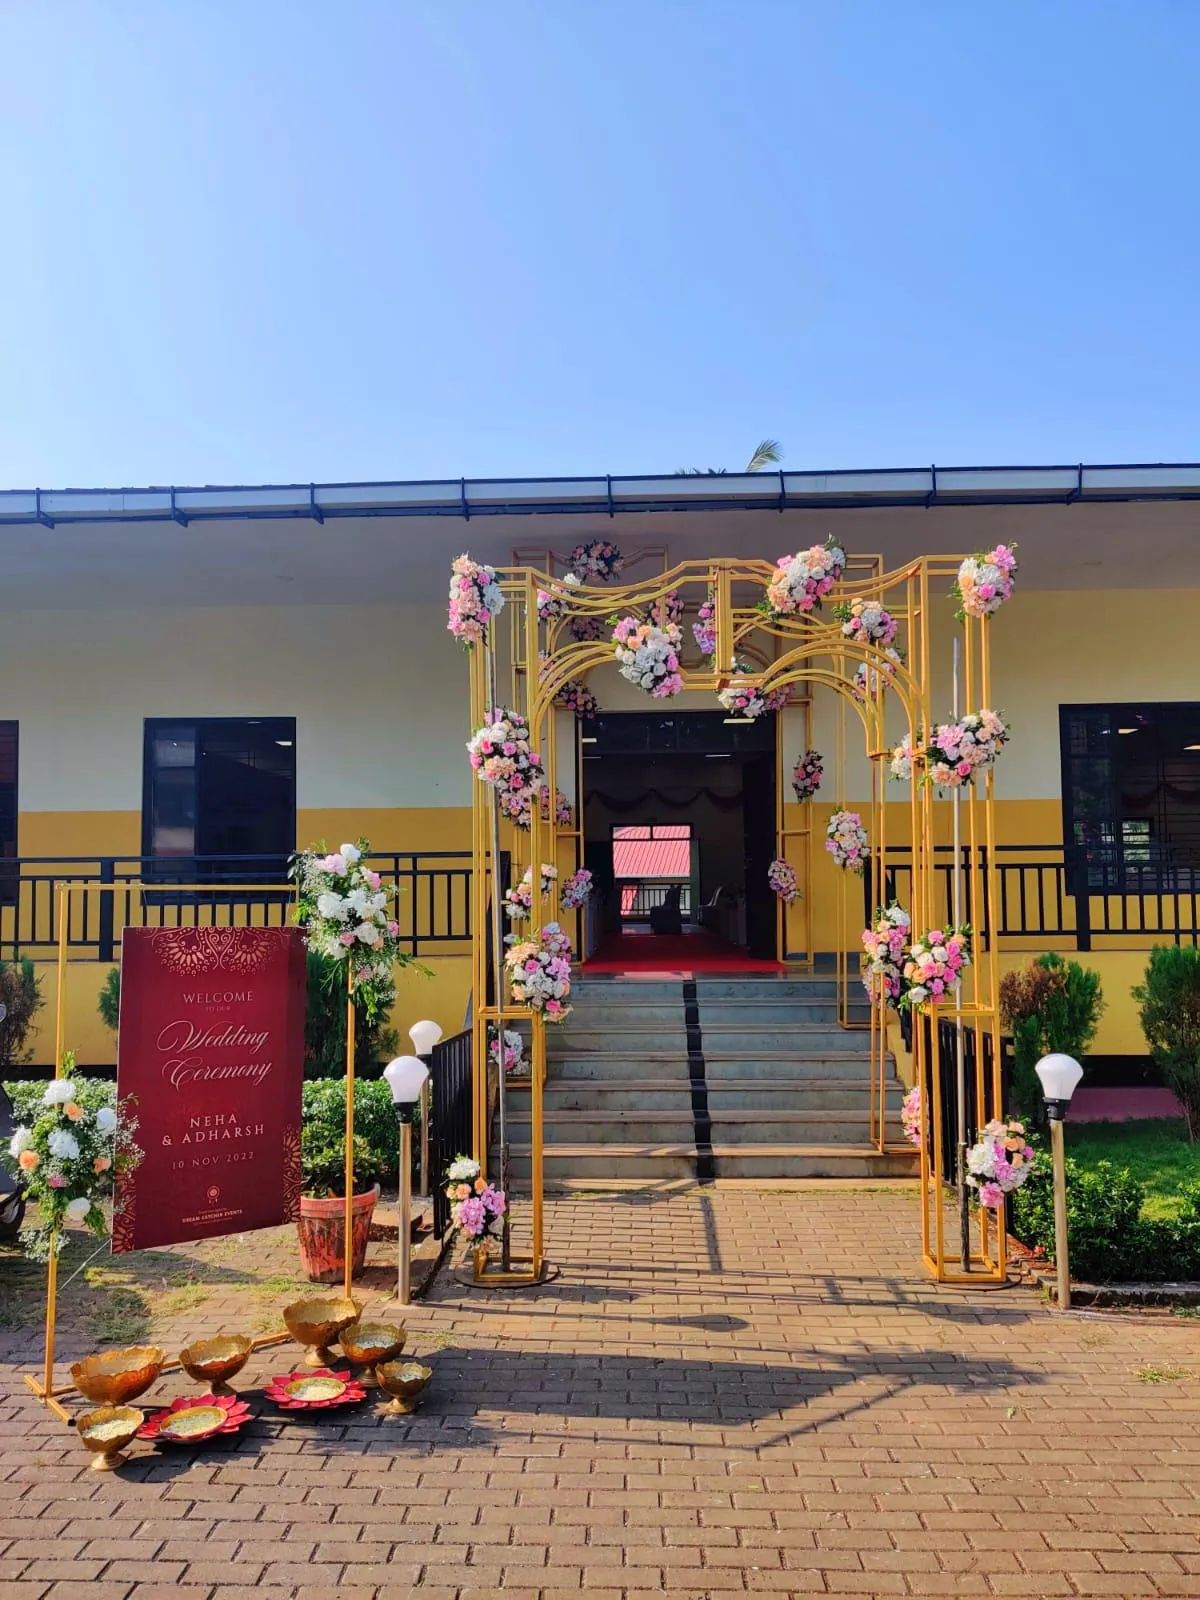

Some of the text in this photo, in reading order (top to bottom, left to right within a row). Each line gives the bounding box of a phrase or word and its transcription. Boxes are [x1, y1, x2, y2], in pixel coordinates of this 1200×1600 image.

[183, 990, 254, 1004] WELCOME
[157, 1020, 269, 1055] Wedding
[162, 1057, 272, 1092] Ceremony
[190, 1113, 237, 1129] NEHA
[162, 1124, 264, 1146] & ADHARSH
[172, 1151, 254, 1170] 10 NOV 2022
